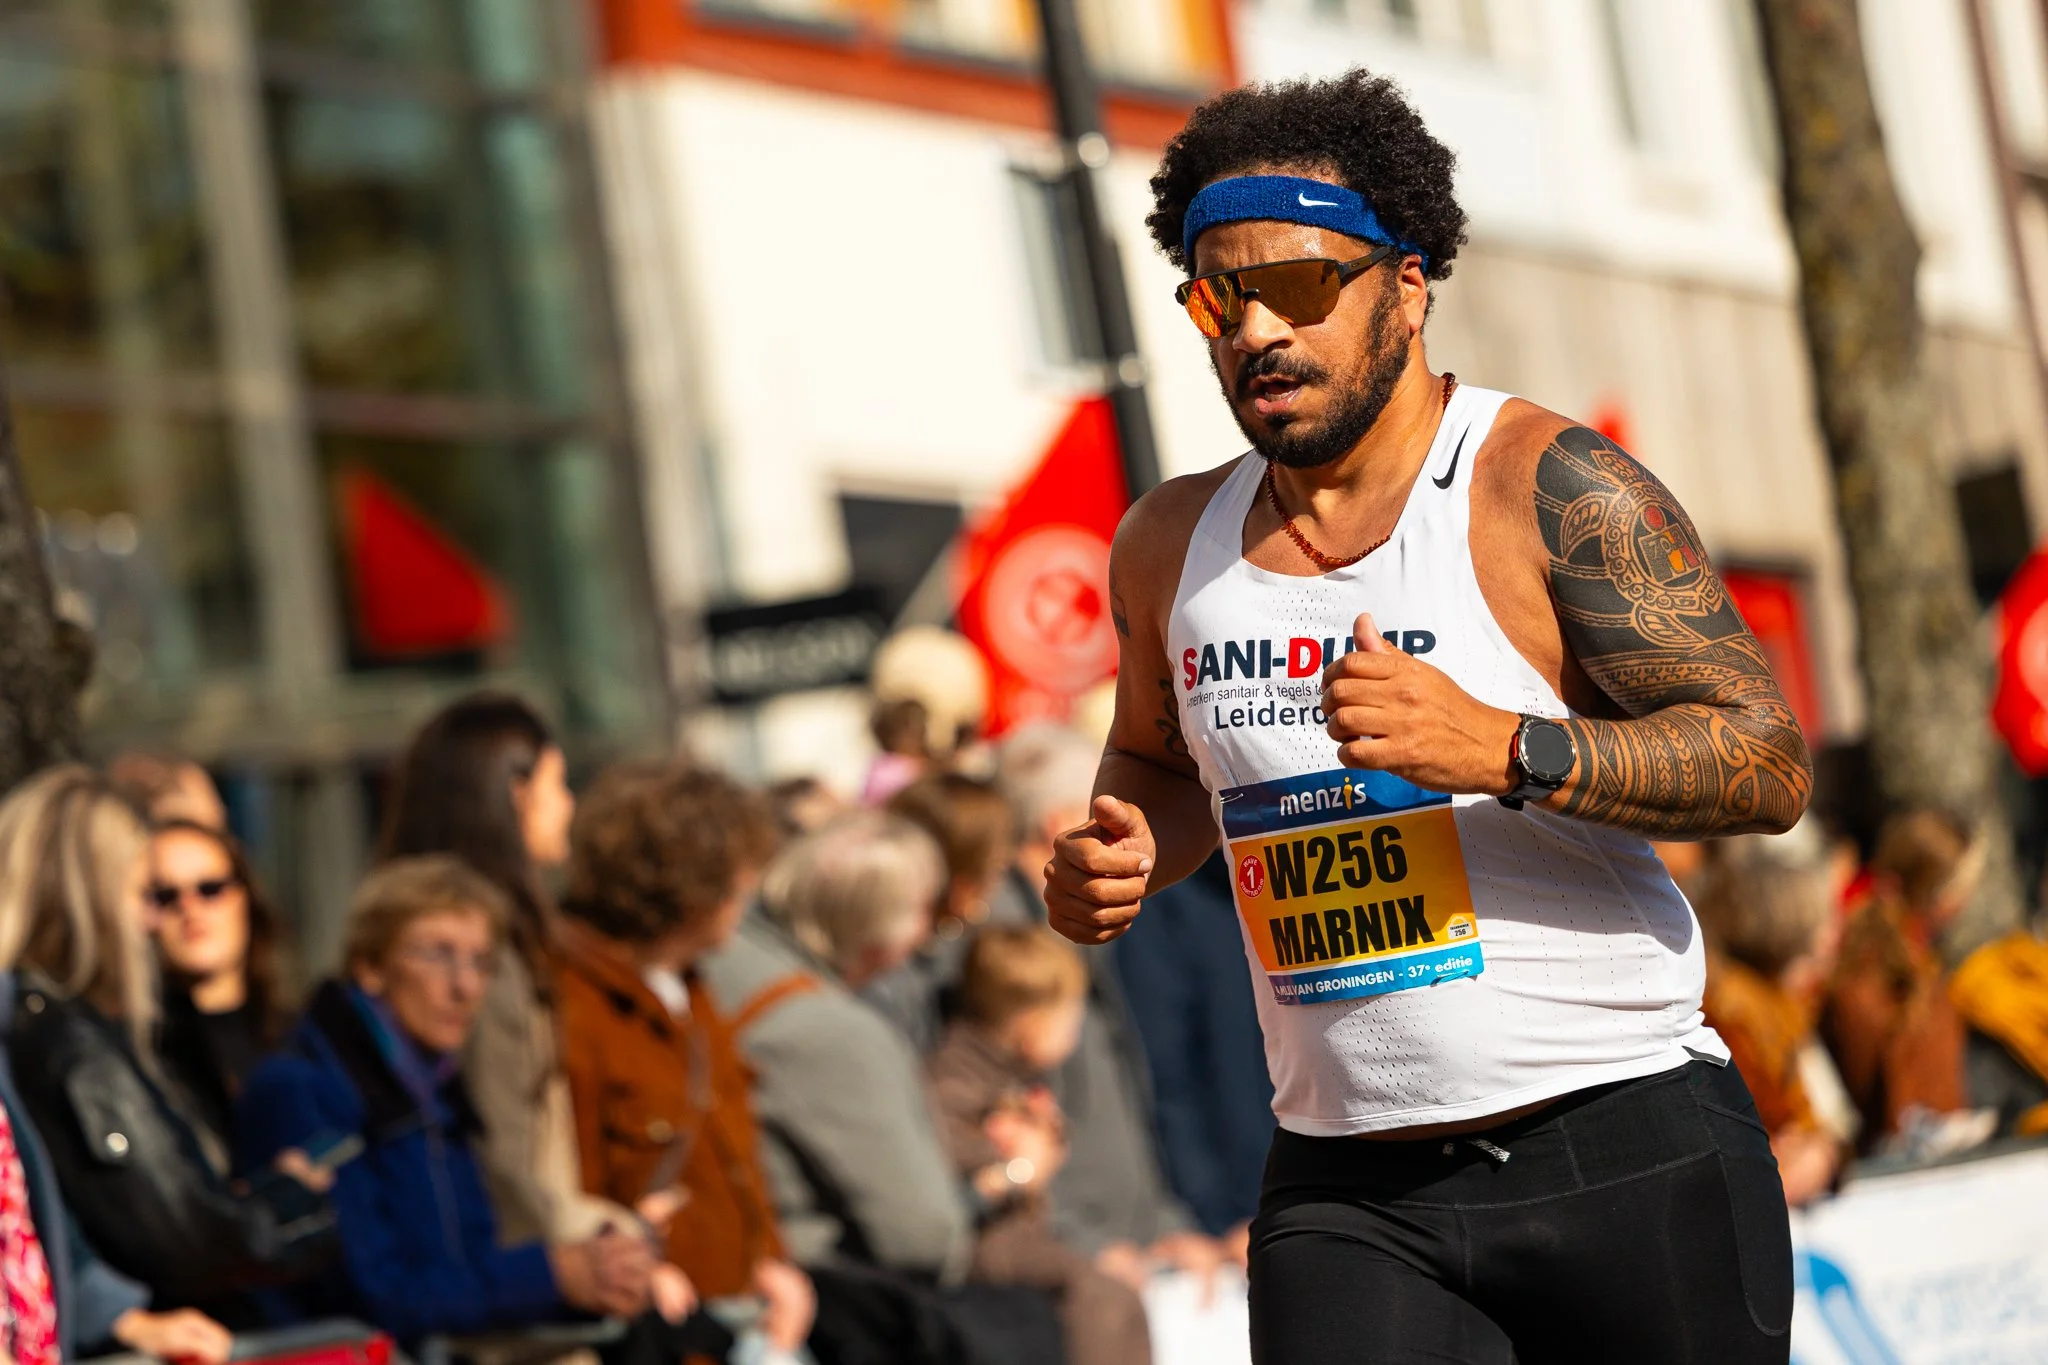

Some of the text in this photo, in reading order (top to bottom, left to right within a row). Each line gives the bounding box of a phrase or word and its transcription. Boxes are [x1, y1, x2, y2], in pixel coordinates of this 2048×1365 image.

[1182, 629, 1436, 691] SANI-DUP
[1218, 685, 1260, 700] sanitair
[1264, 684, 1273, 698] &
[1277, 683, 1312, 700] tegels
[1280, 776, 1367, 816] menzis
[1247, 866, 1255, 889] 1
[1263, 824, 1408, 900] W256
[1269, 895, 1435, 967] MARNIX
[1454, 928, 1466, 936] 256
[1292, 983, 1314, 996] VAN
[1315, 970, 1394, 993] GRONINGEN
[1434, 955, 1473, 973] editie
